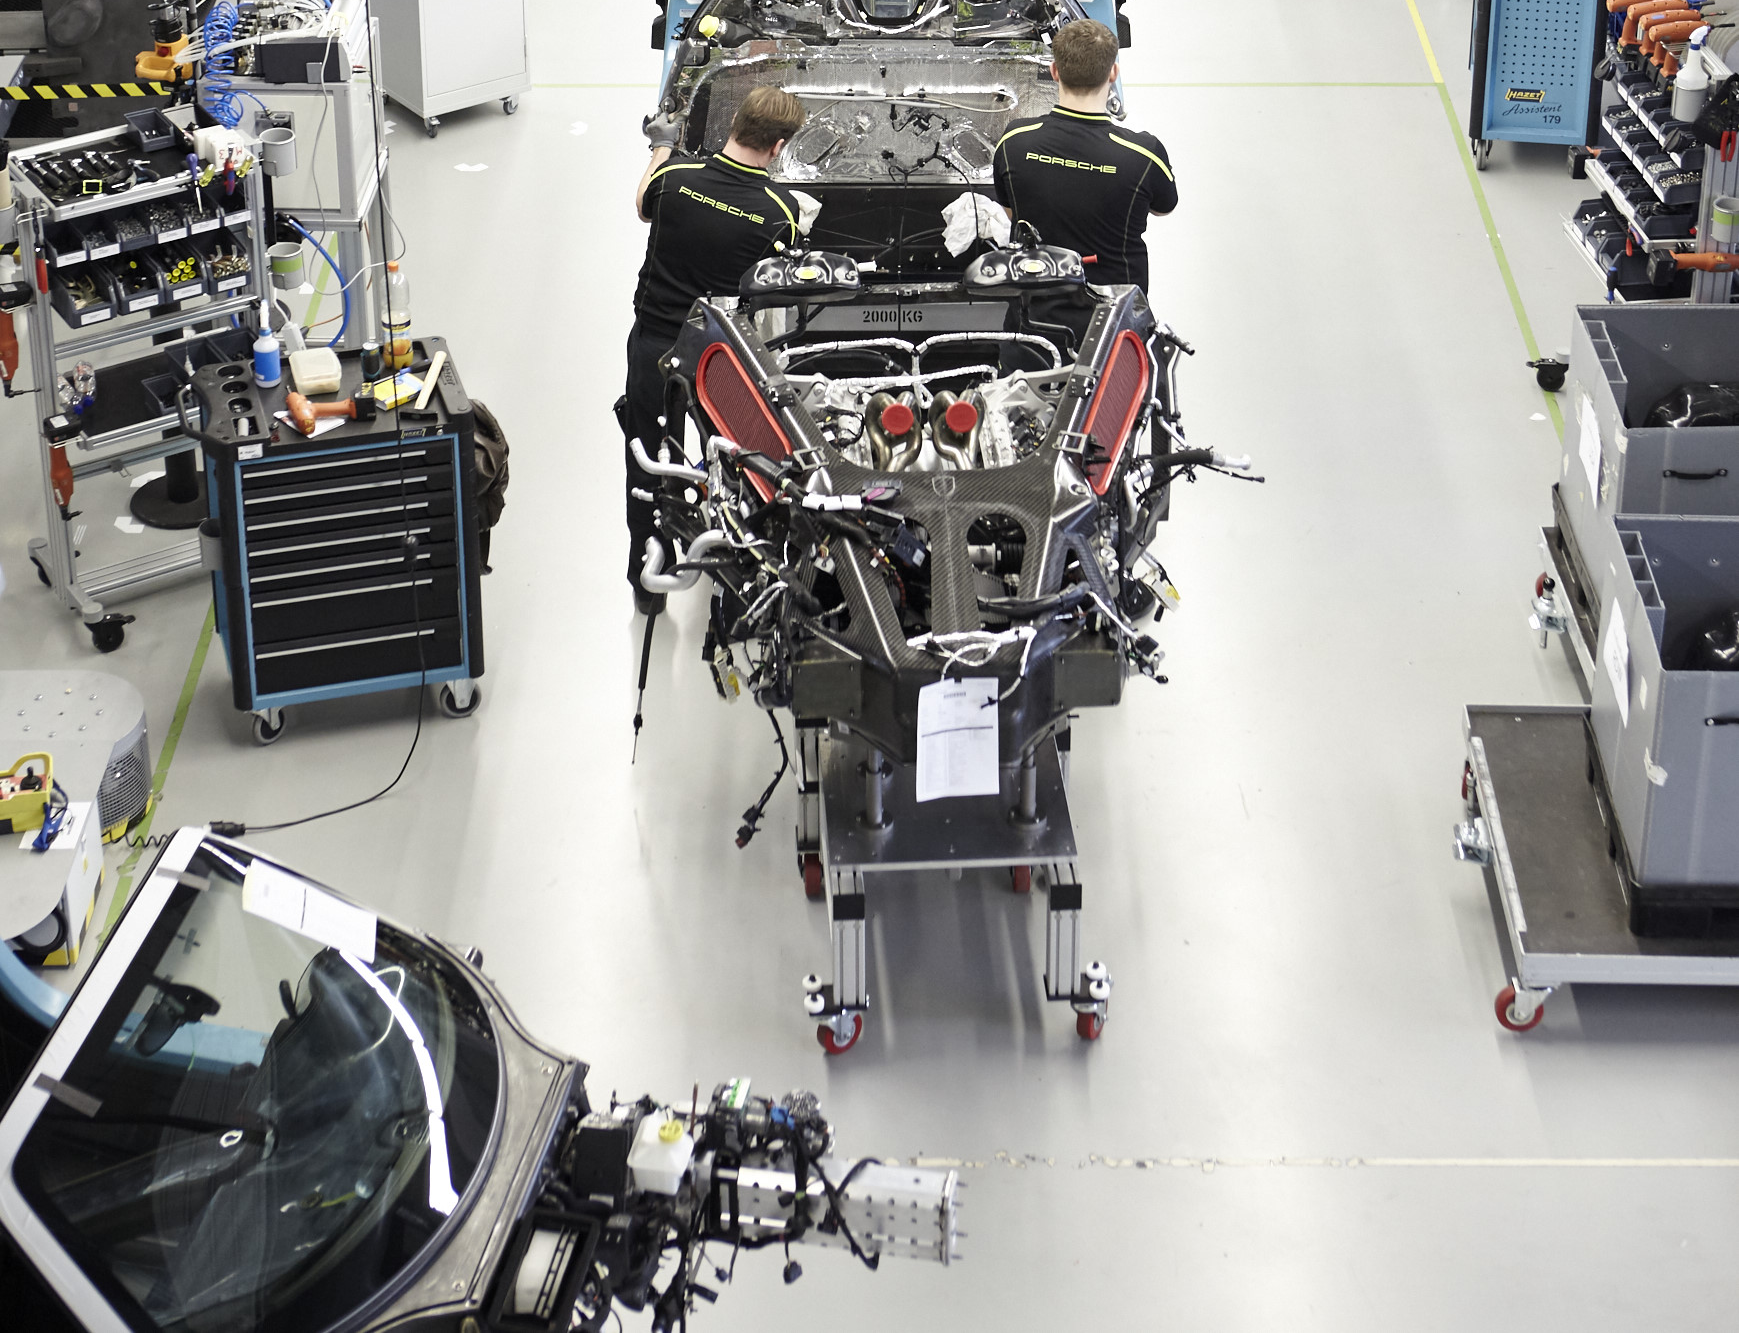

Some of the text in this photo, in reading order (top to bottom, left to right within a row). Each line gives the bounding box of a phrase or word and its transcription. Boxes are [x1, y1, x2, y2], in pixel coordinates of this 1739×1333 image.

[1502, 103, 1562, 116] Assistent
[1543, 115, 1561, 124] 179
[1025, 152, 1117, 174] PORSCHE
[678, 185, 765, 225] PORSCHE
[862, 310, 923, 323] 2000 KG
